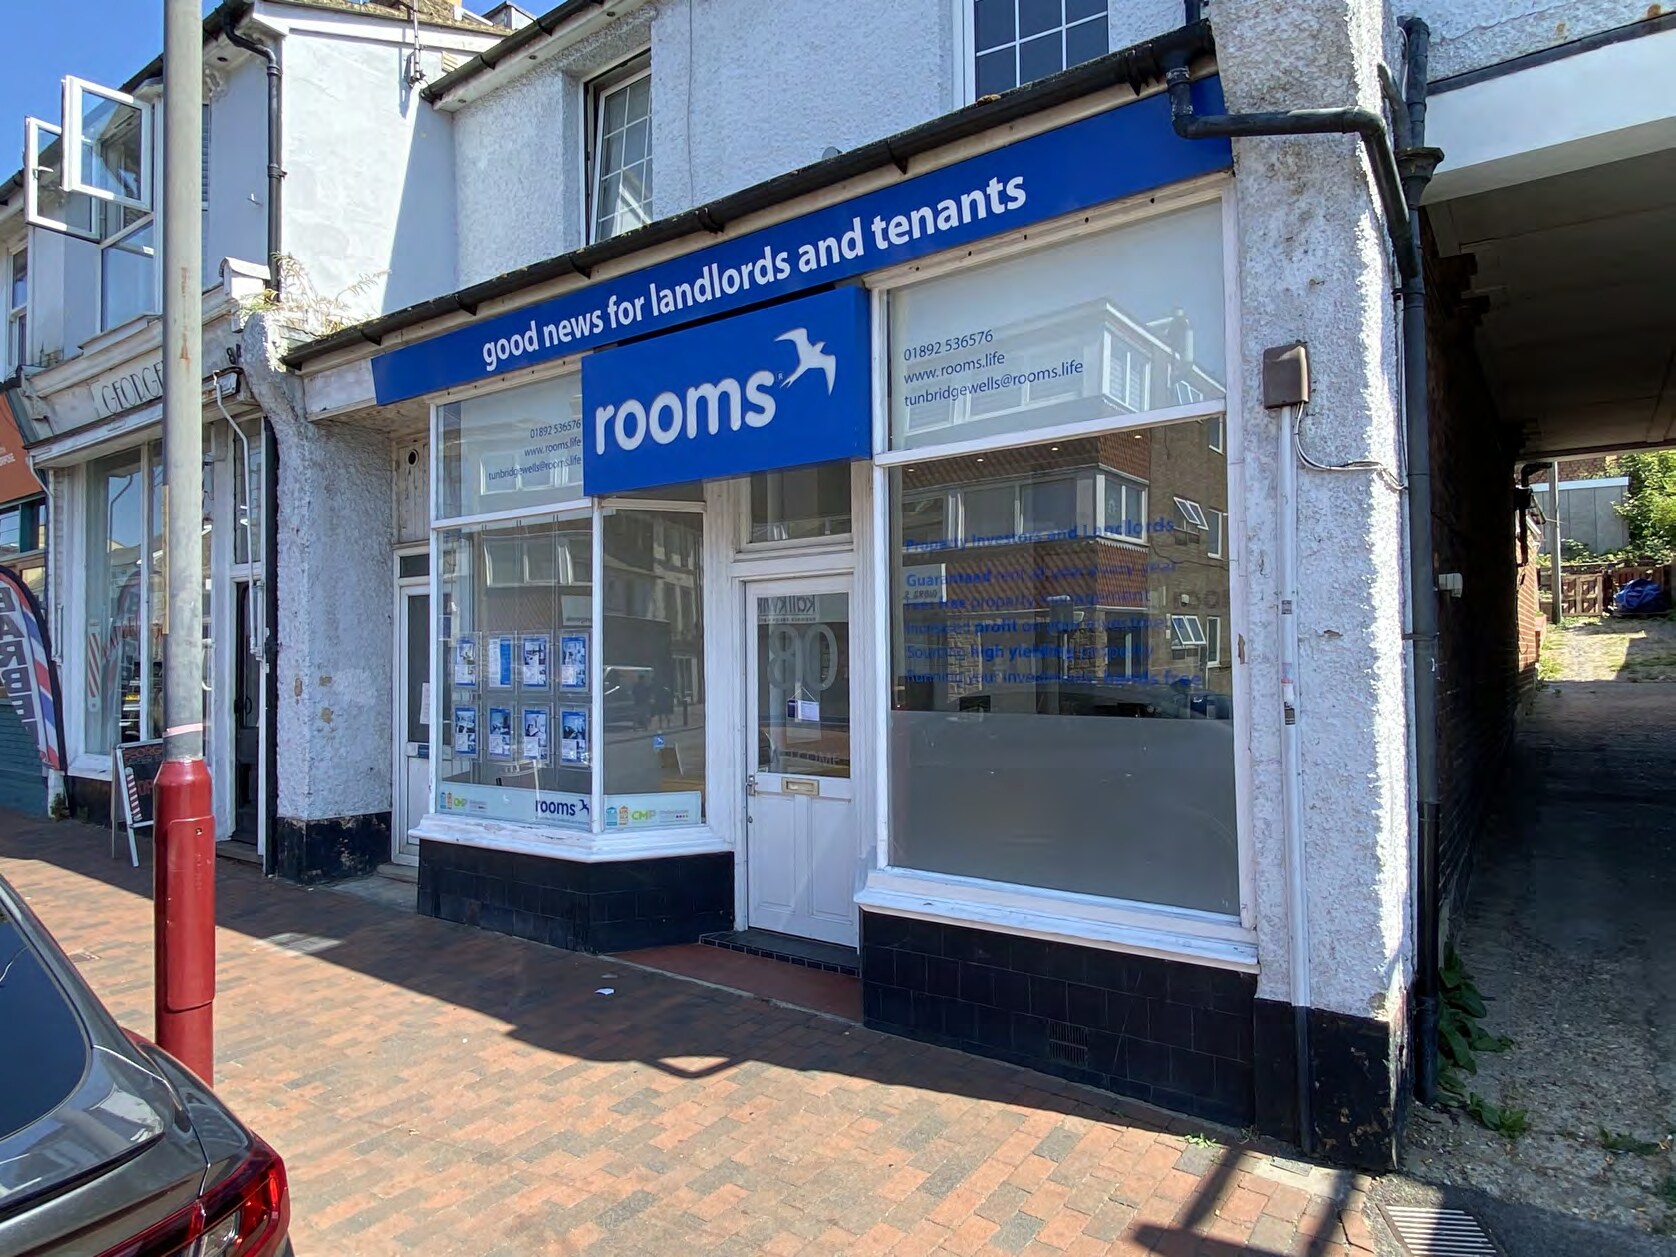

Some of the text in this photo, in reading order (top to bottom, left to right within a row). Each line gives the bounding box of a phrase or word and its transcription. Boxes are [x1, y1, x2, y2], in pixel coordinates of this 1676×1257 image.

[483, 176, 1027, 371] good news for landlords and tenants
[904, 329, 993, 361] 01892 536576
[904, 351, 1005, 384] www.rooms.life
[904, 359, 1084, 407] tunbridgewells@rooms.life
[595, 370, 777, 456] rooms
[530, 418, 582, 438] 01892 536576
[524, 436, 582, 457] www.rooms.life
[971, 643, 1004, 662] high
[535, 799, 577, 817] rooms
[632, 810, 656, 821] CMP
